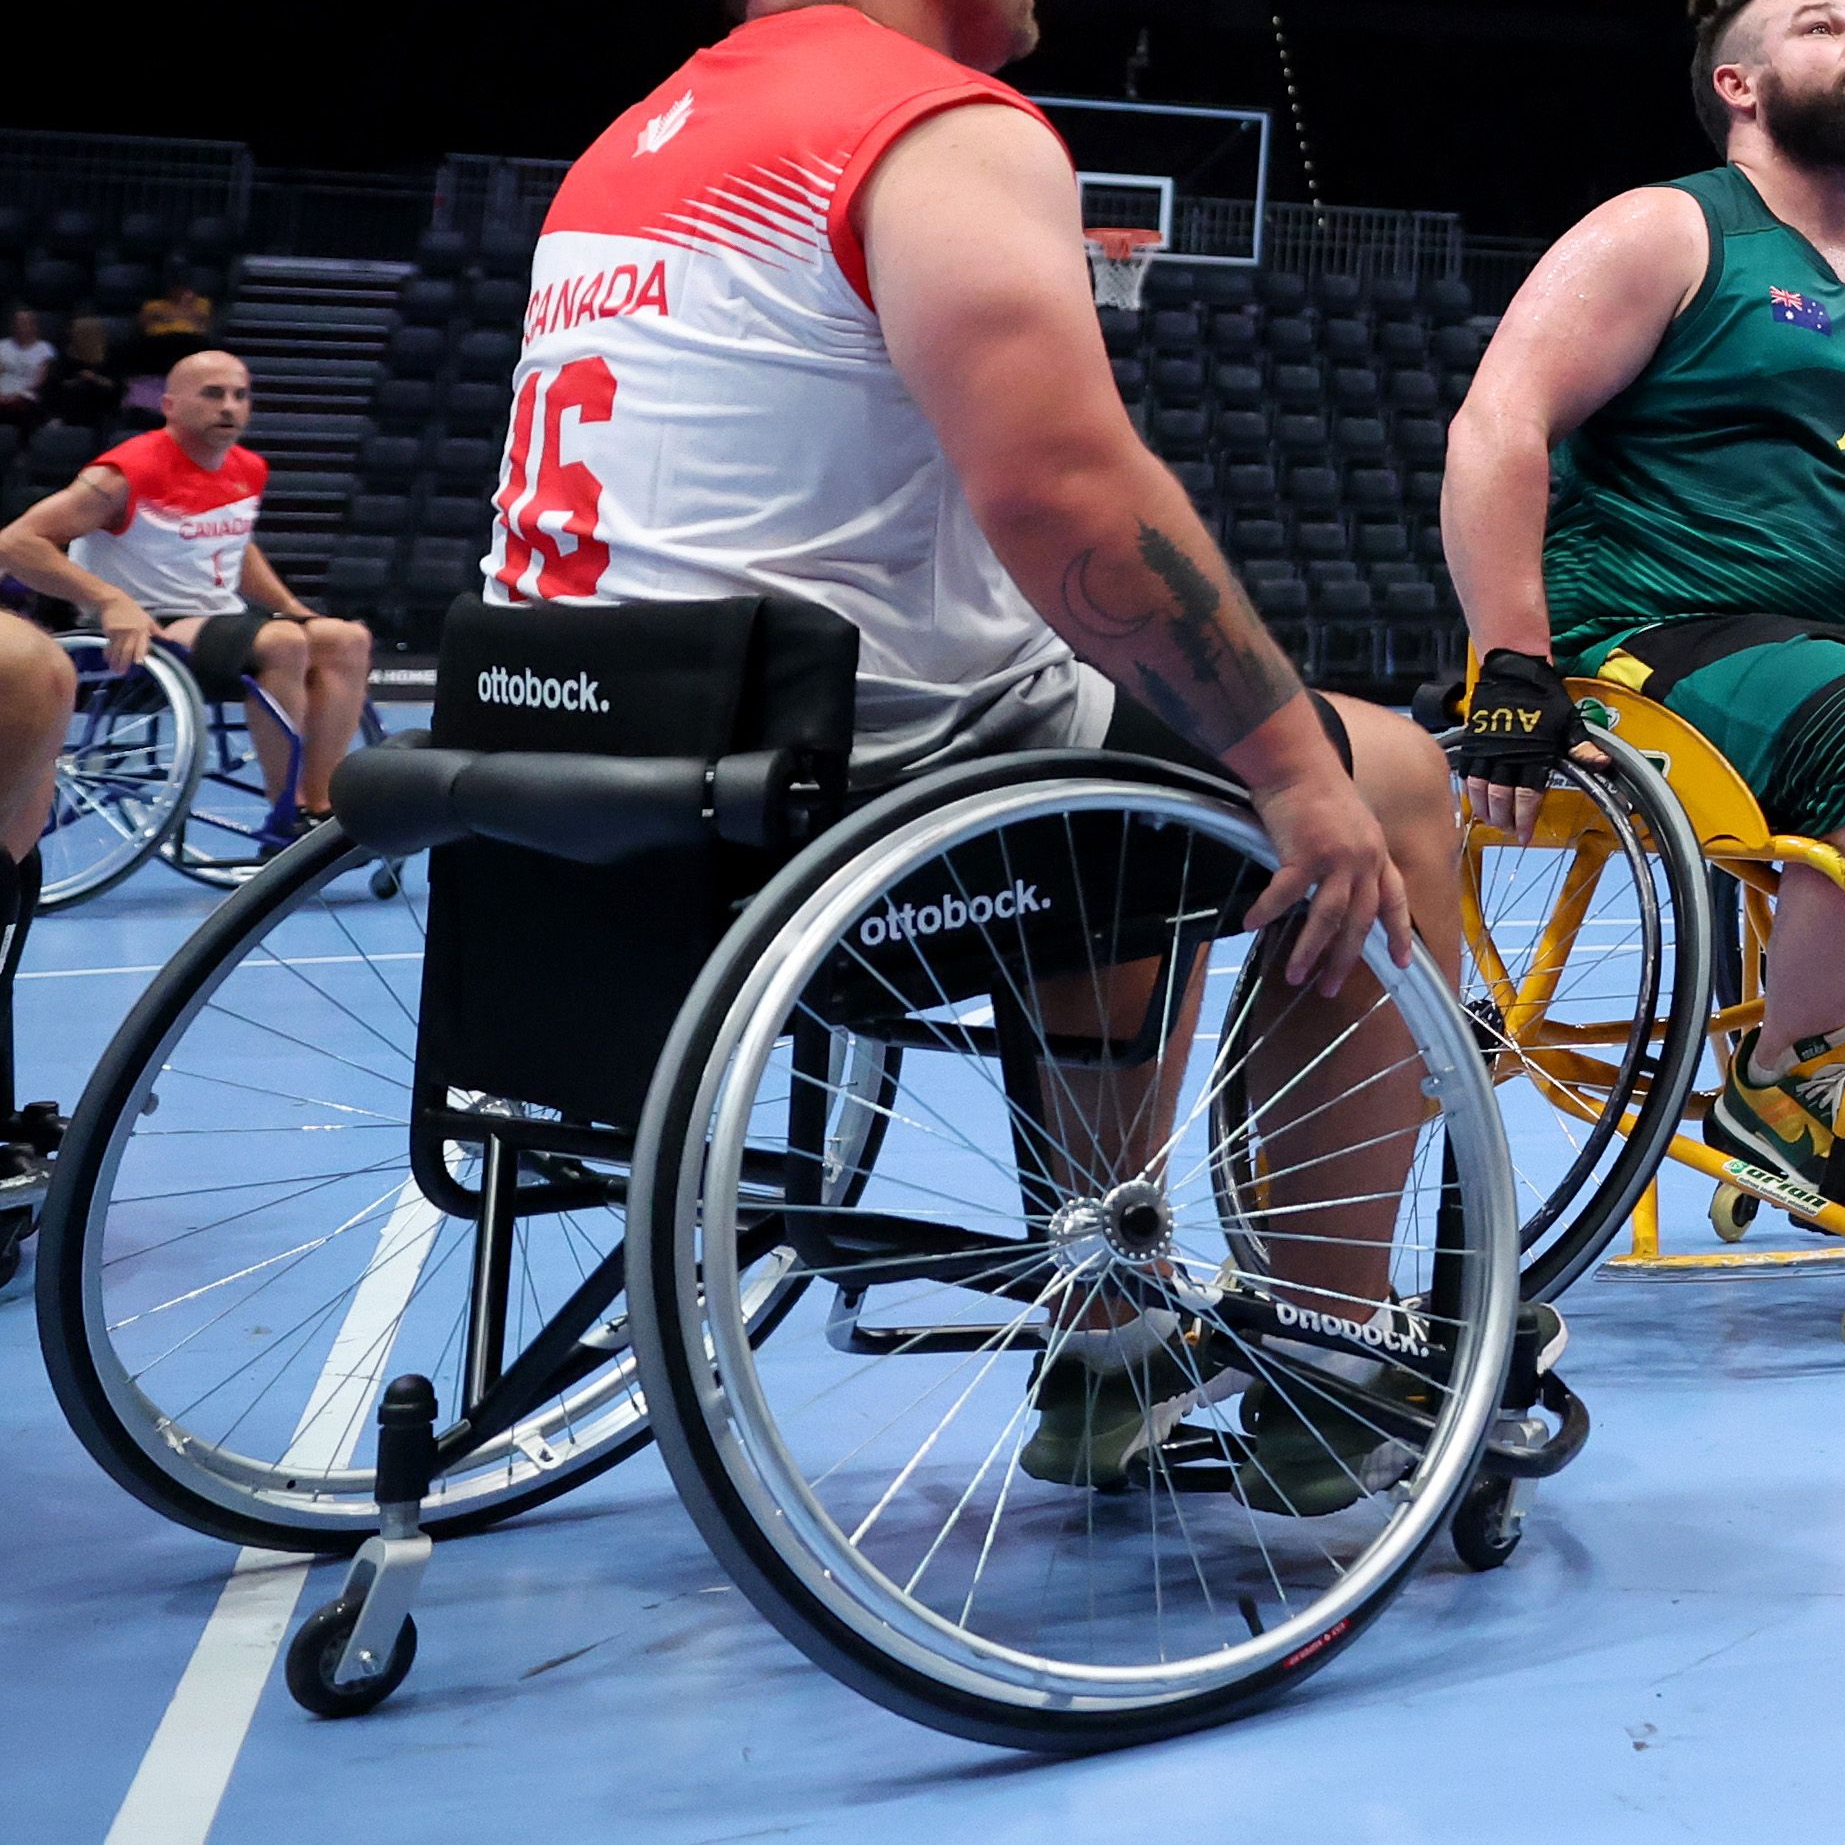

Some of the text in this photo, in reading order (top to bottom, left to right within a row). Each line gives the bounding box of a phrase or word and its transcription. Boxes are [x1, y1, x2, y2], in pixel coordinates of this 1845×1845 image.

[524, 258, 669, 347] CANADA
[496, 355, 618, 602] 16
[477, 663, 611, 714] ottobock.
[1471, 705, 1543, 736] AUS
[860, 877, 1052, 949] ottobock.
